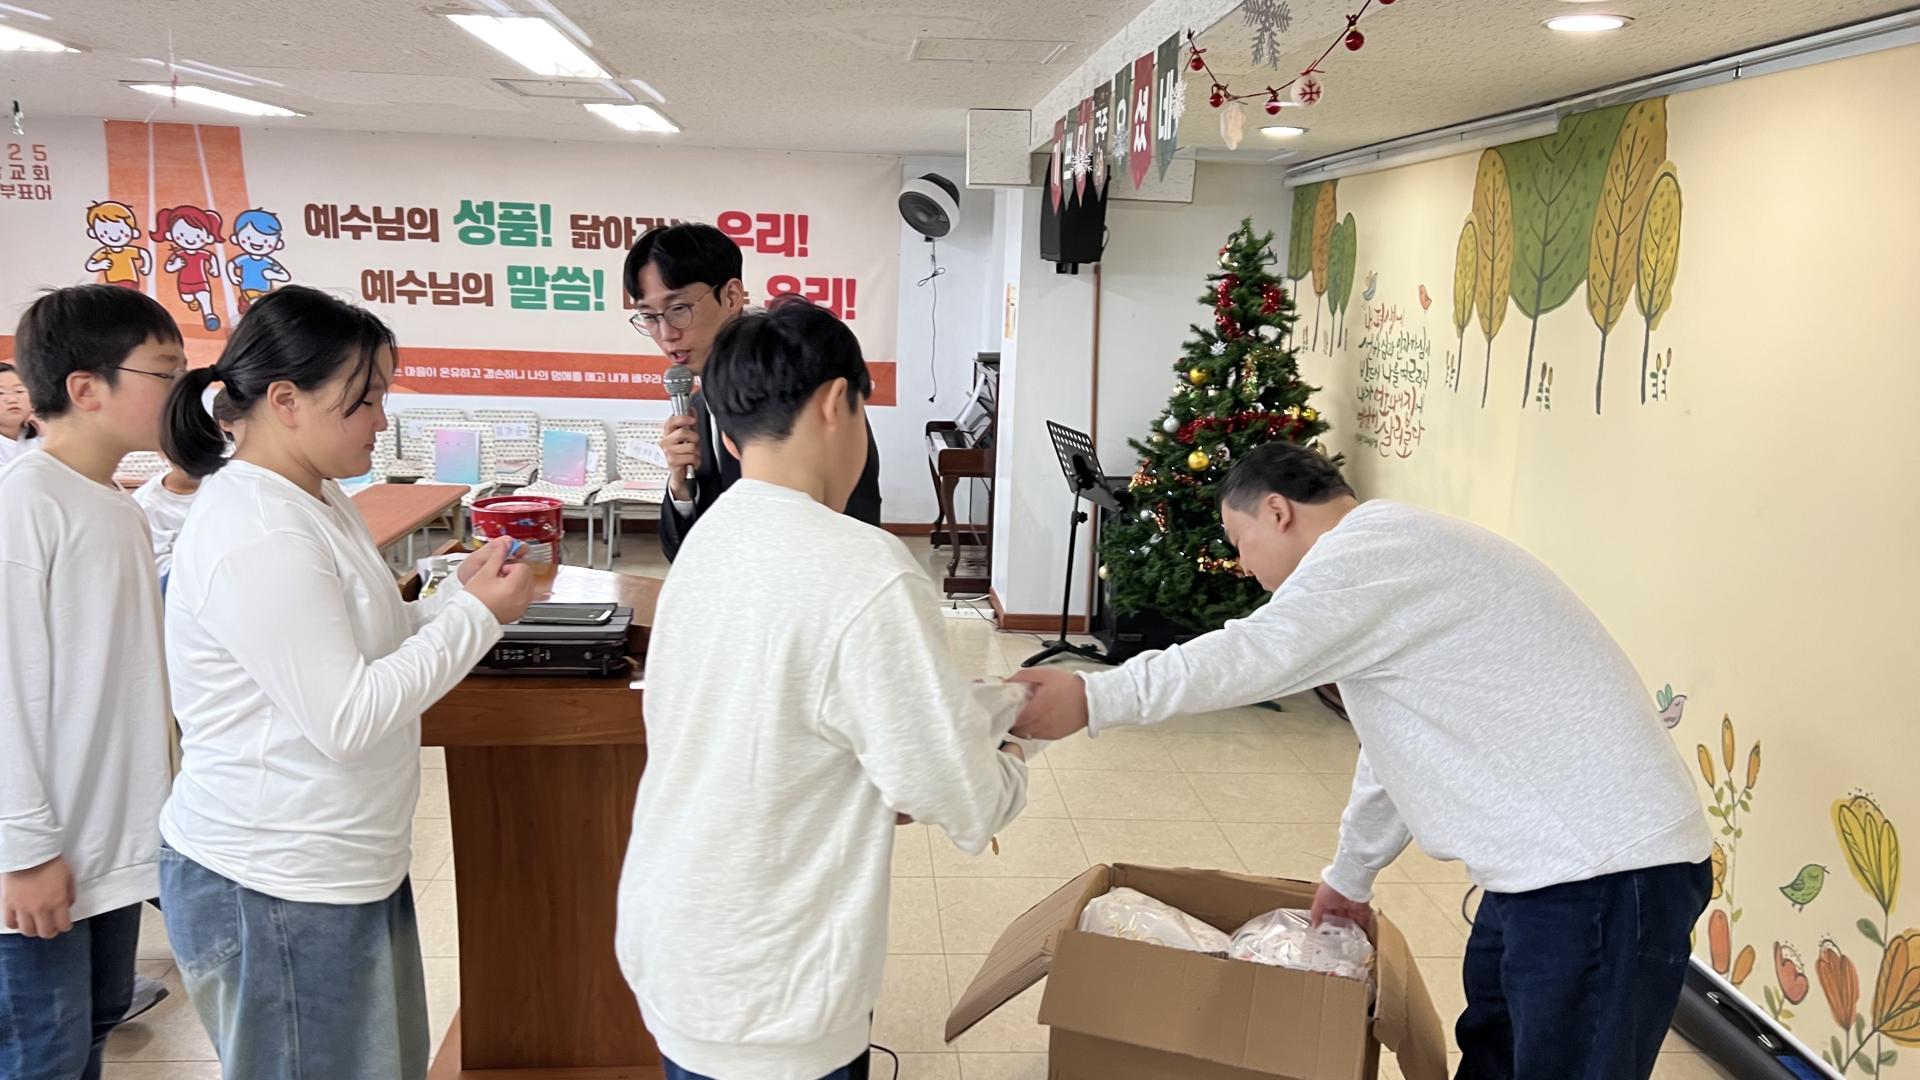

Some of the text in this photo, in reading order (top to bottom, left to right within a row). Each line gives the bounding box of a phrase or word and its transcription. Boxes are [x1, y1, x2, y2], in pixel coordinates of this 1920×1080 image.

[0, 164, 50, 181] 교회
[304, 199, 809, 258] 예수님의 성품! 닮아 우리!
[361, 269, 493, 307] 예수님의
[506, 265, 605, 312] 말씀!
[763, 275, 857, 320] 우리!
[405, 366, 437, 377] 마음이
[439, 367, 481, 379] 온유하고
[483, 368, 525, 380] 겸손하니
[527, 370, 549, 381] 나의
[551, 370, 582, 382] 멍에를
[585, 371, 606, 383] 메고
[608, 372, 630, 384] 내게
[632, 373, 662, 386] 배우라
